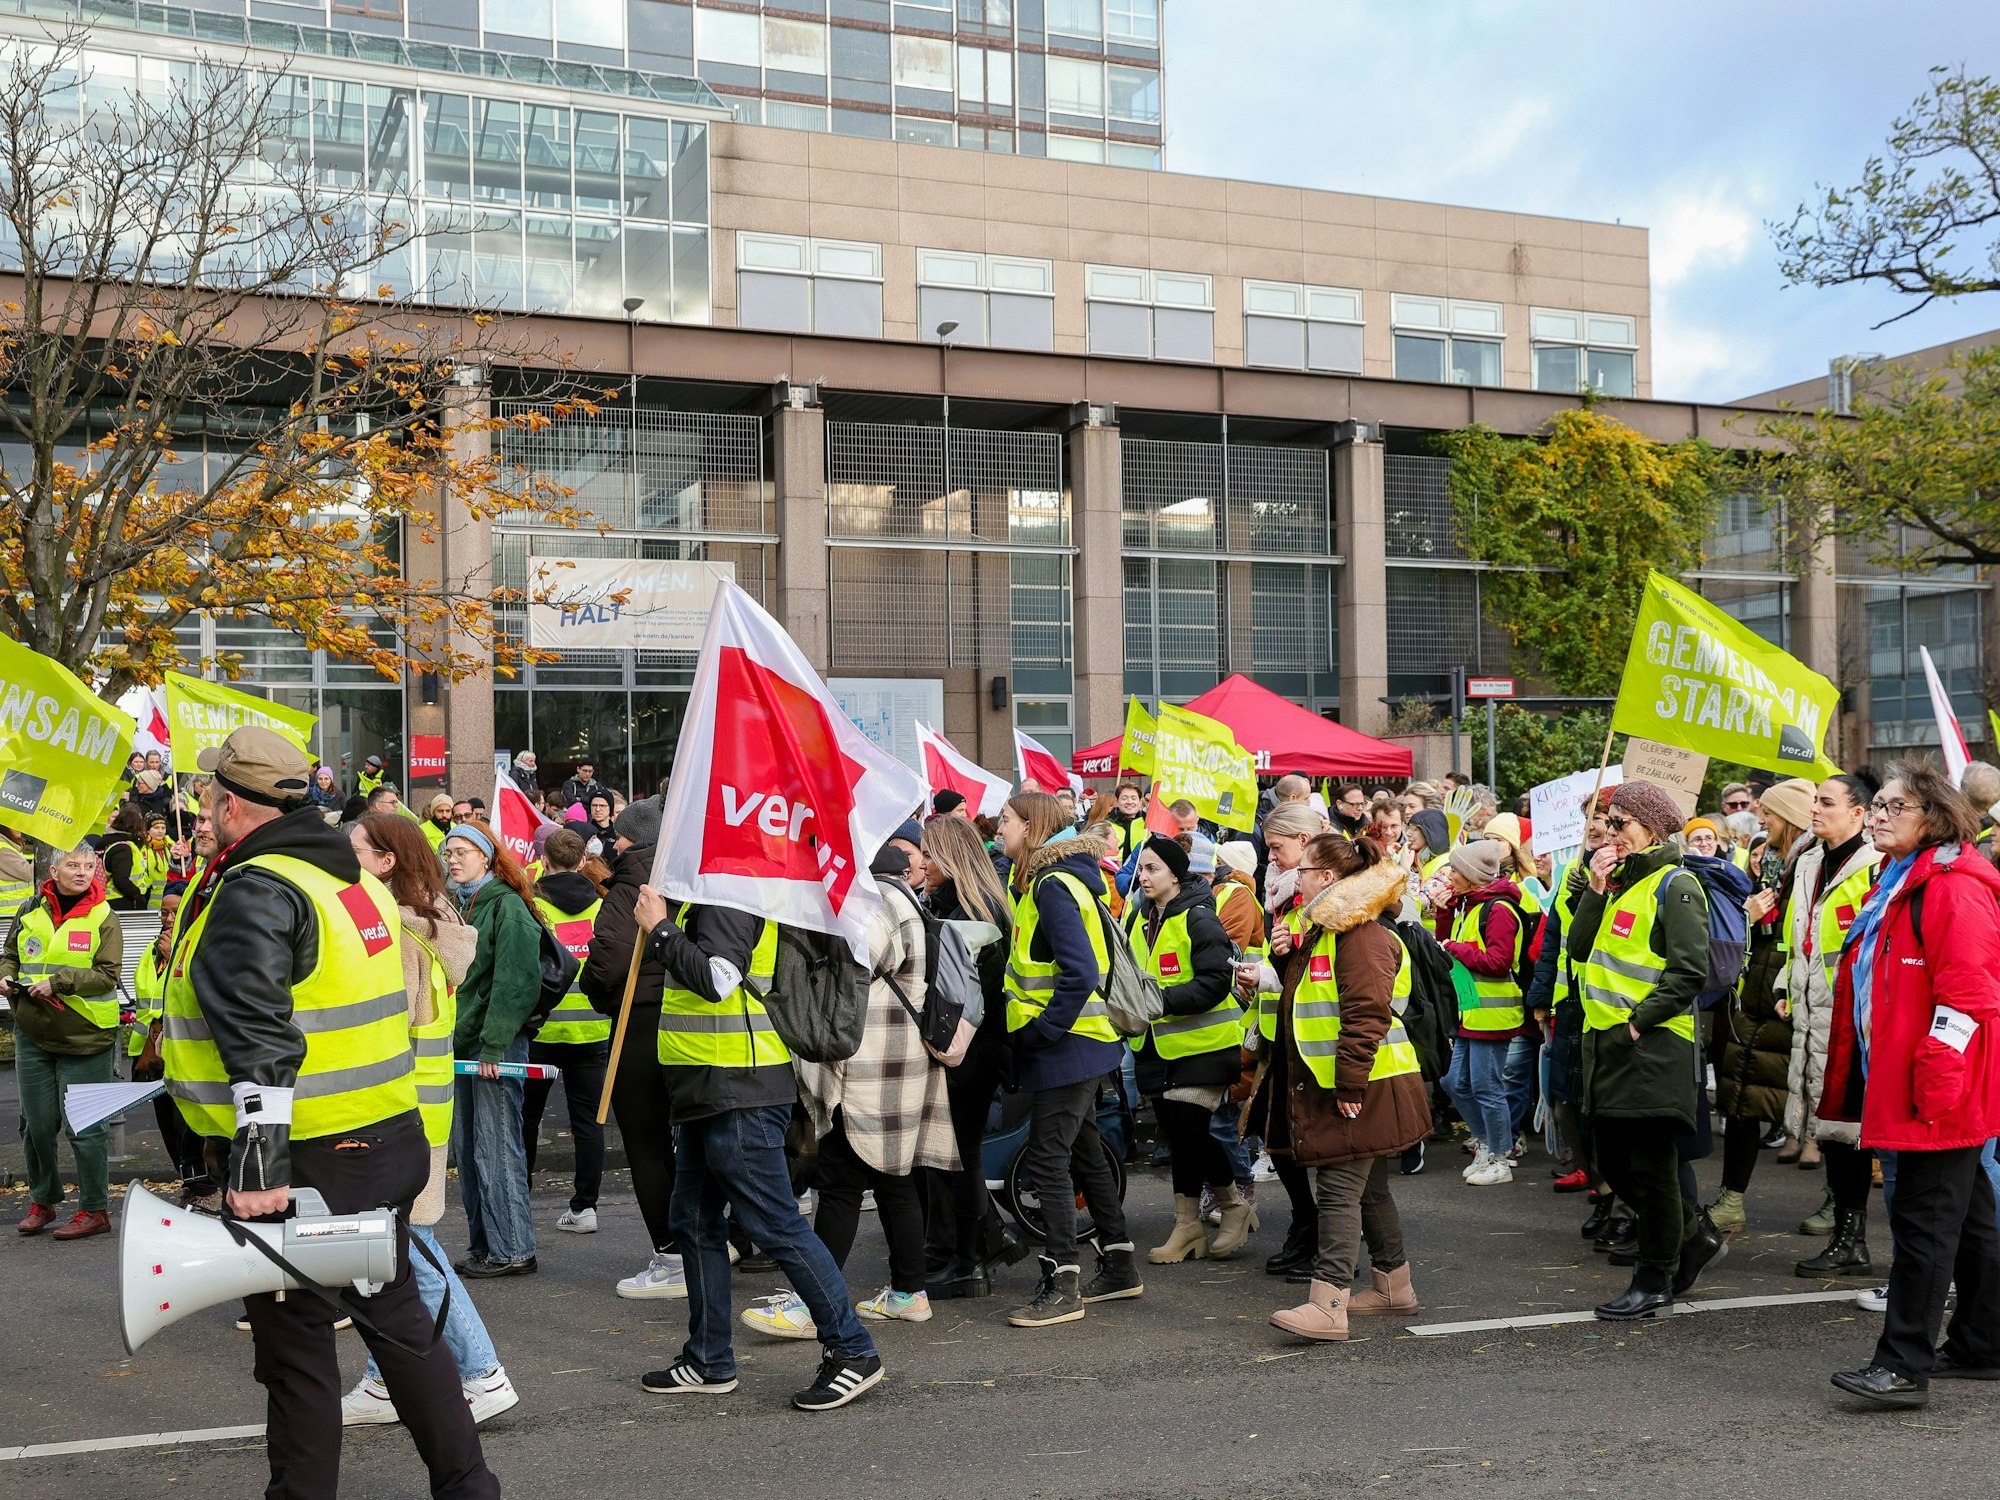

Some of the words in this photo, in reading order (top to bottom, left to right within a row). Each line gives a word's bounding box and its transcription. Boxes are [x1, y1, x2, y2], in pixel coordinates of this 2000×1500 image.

[560, 602, 625, 627] HALT
[1655, 674, 1774, 739] STARK
[0, 679, 121, 765] NSAM
[1676, 751, 1690, 760] JOB
[1781, 743, 1814, 759] ver.di
[1647, 757, 1676, 769] GLEICHE
[1159, 765, 1218, 800] STARK
[1, 789, 36, 810] ver.di
[1536, 780, 1570, 805] KITAS
[1552, 798, 1569, 811] VOR
[38, 805, 74, 825] JUGEND
[360, 921, 388, 941] ver.di
[1612, 923, 1631, 935] ver.di
[69, 942, 89, 950] ver.di
[1160, 964, 1179, 972] ver.di
[1901, 957, 1926, 966] ver.di
[1310, 970, 1331, 978] ver.di
